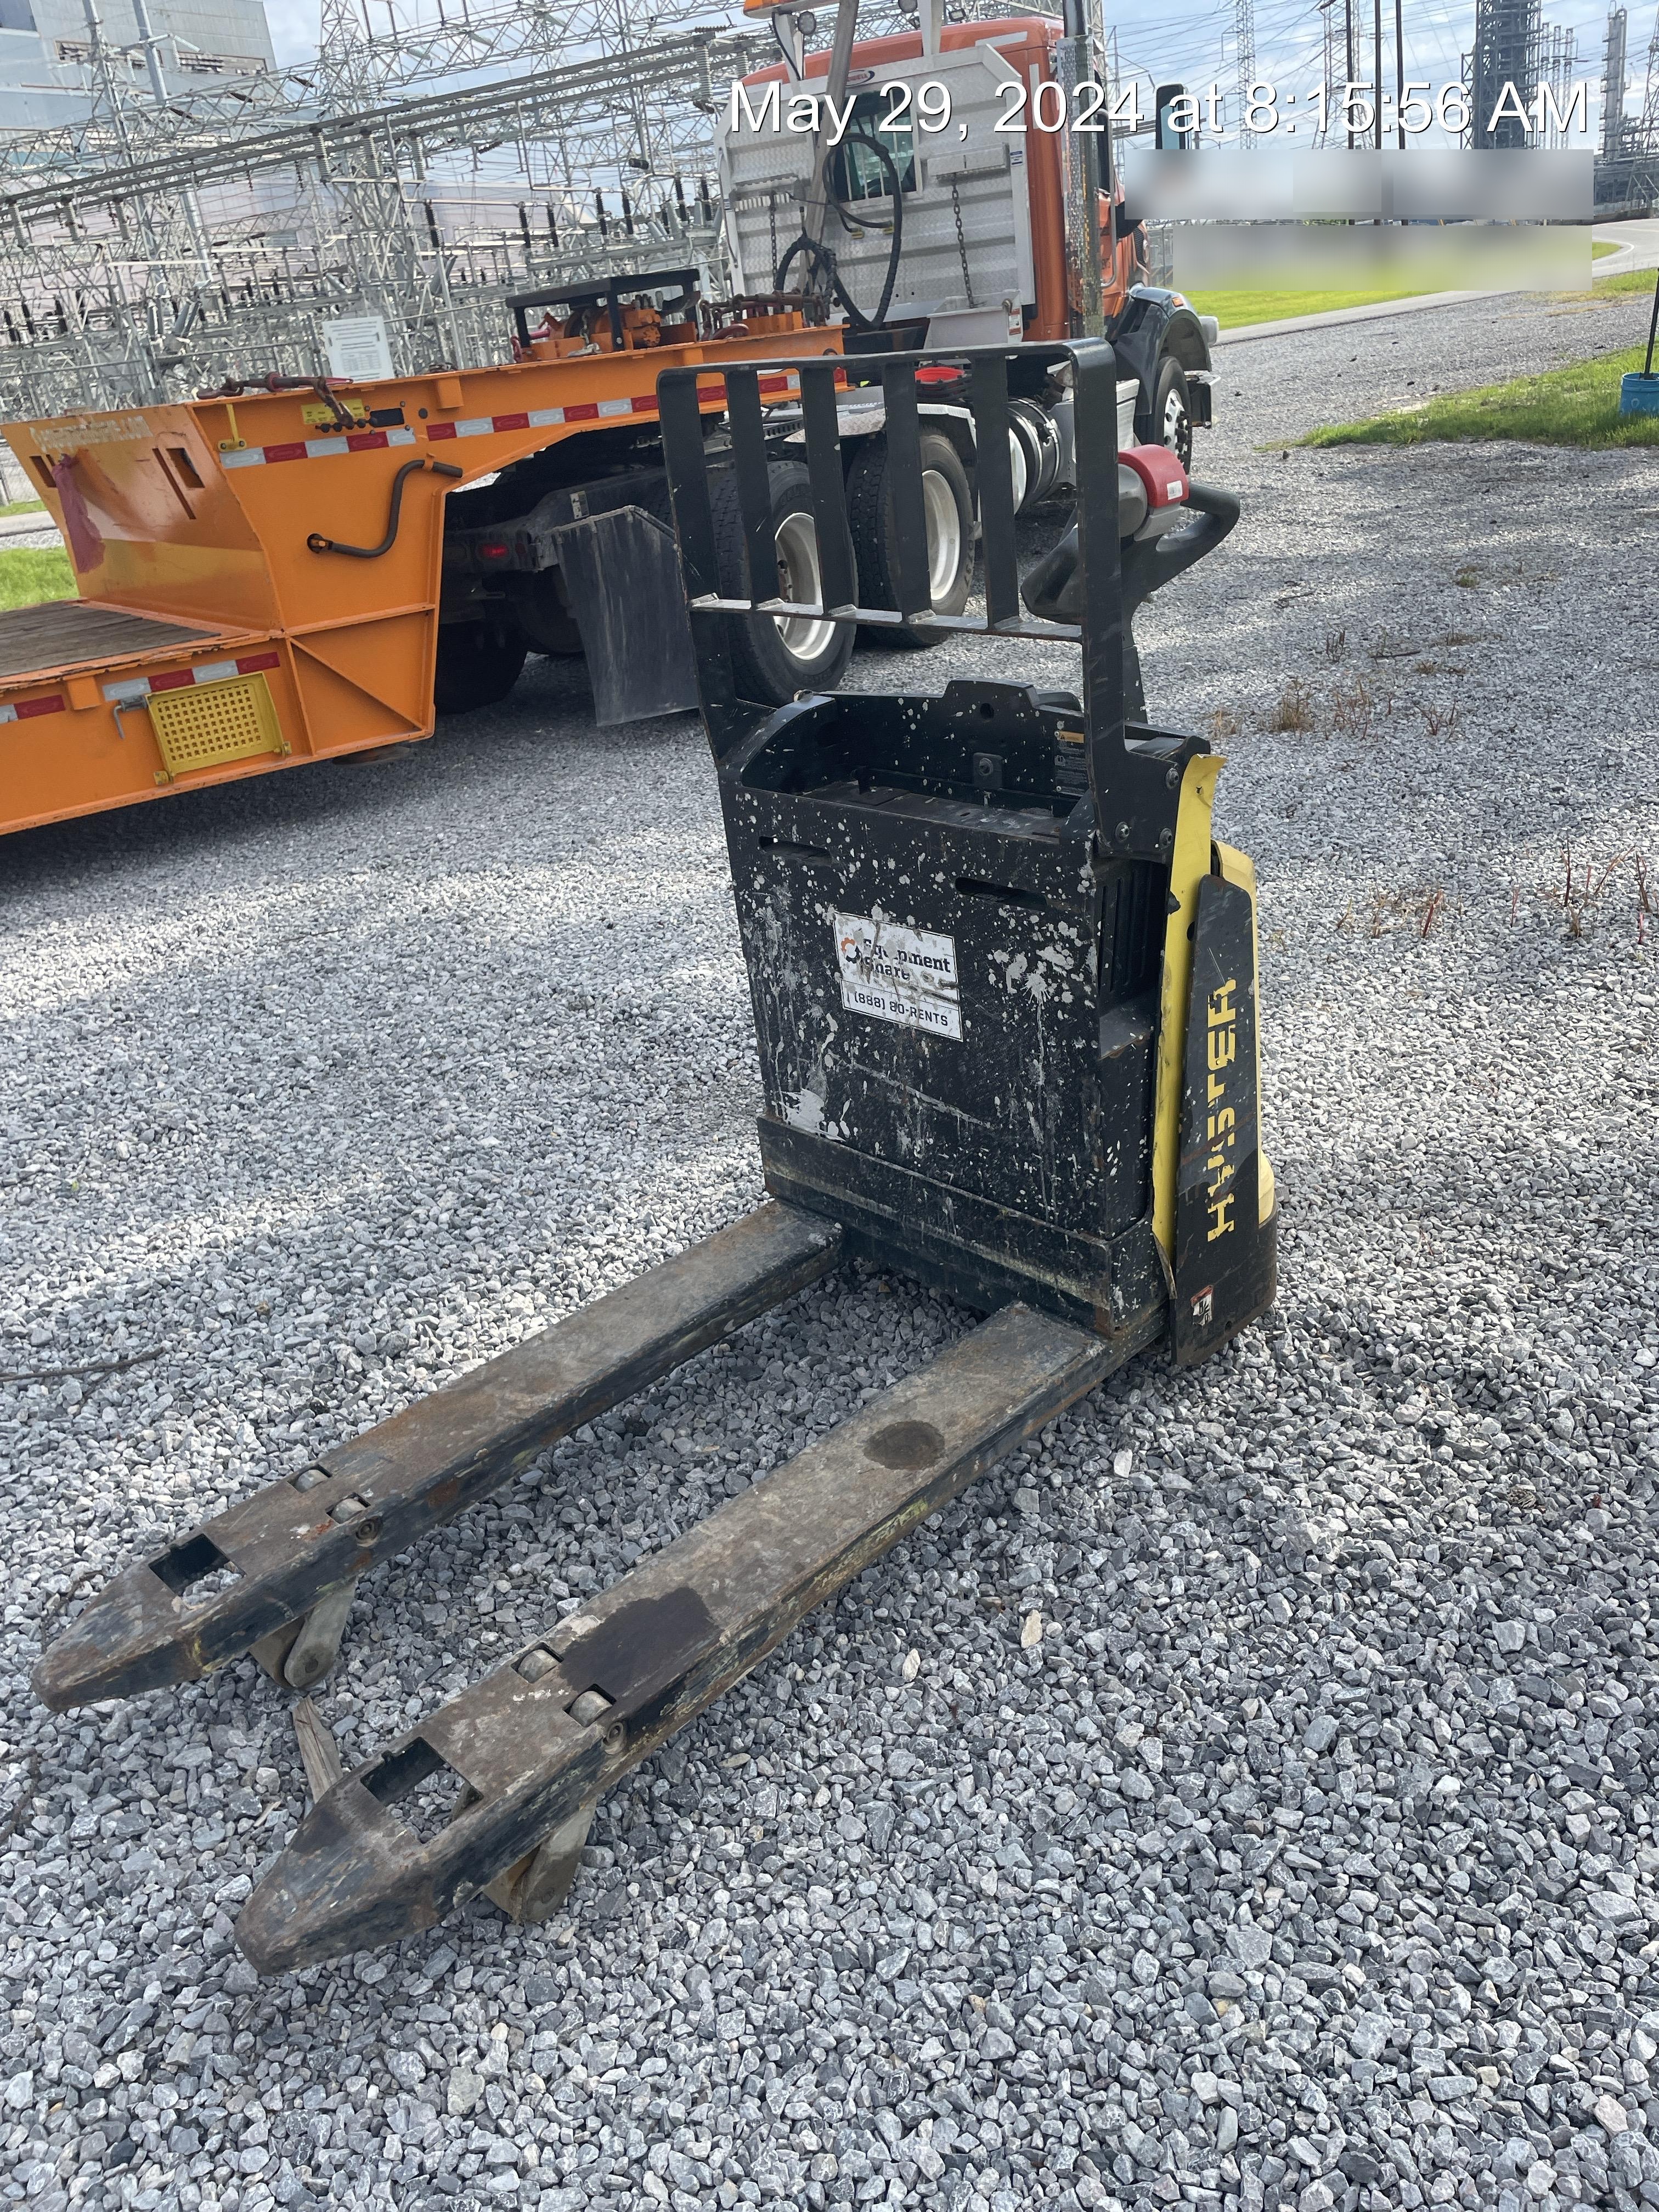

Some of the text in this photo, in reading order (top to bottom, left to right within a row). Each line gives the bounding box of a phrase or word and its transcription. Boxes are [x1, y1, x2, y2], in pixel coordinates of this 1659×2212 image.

[863, 938, 951, 973] Equpment
[854, 991, 949, 1026] (888) 80-RENTS
[1207, 979, 1237, 1242] HYSTER
